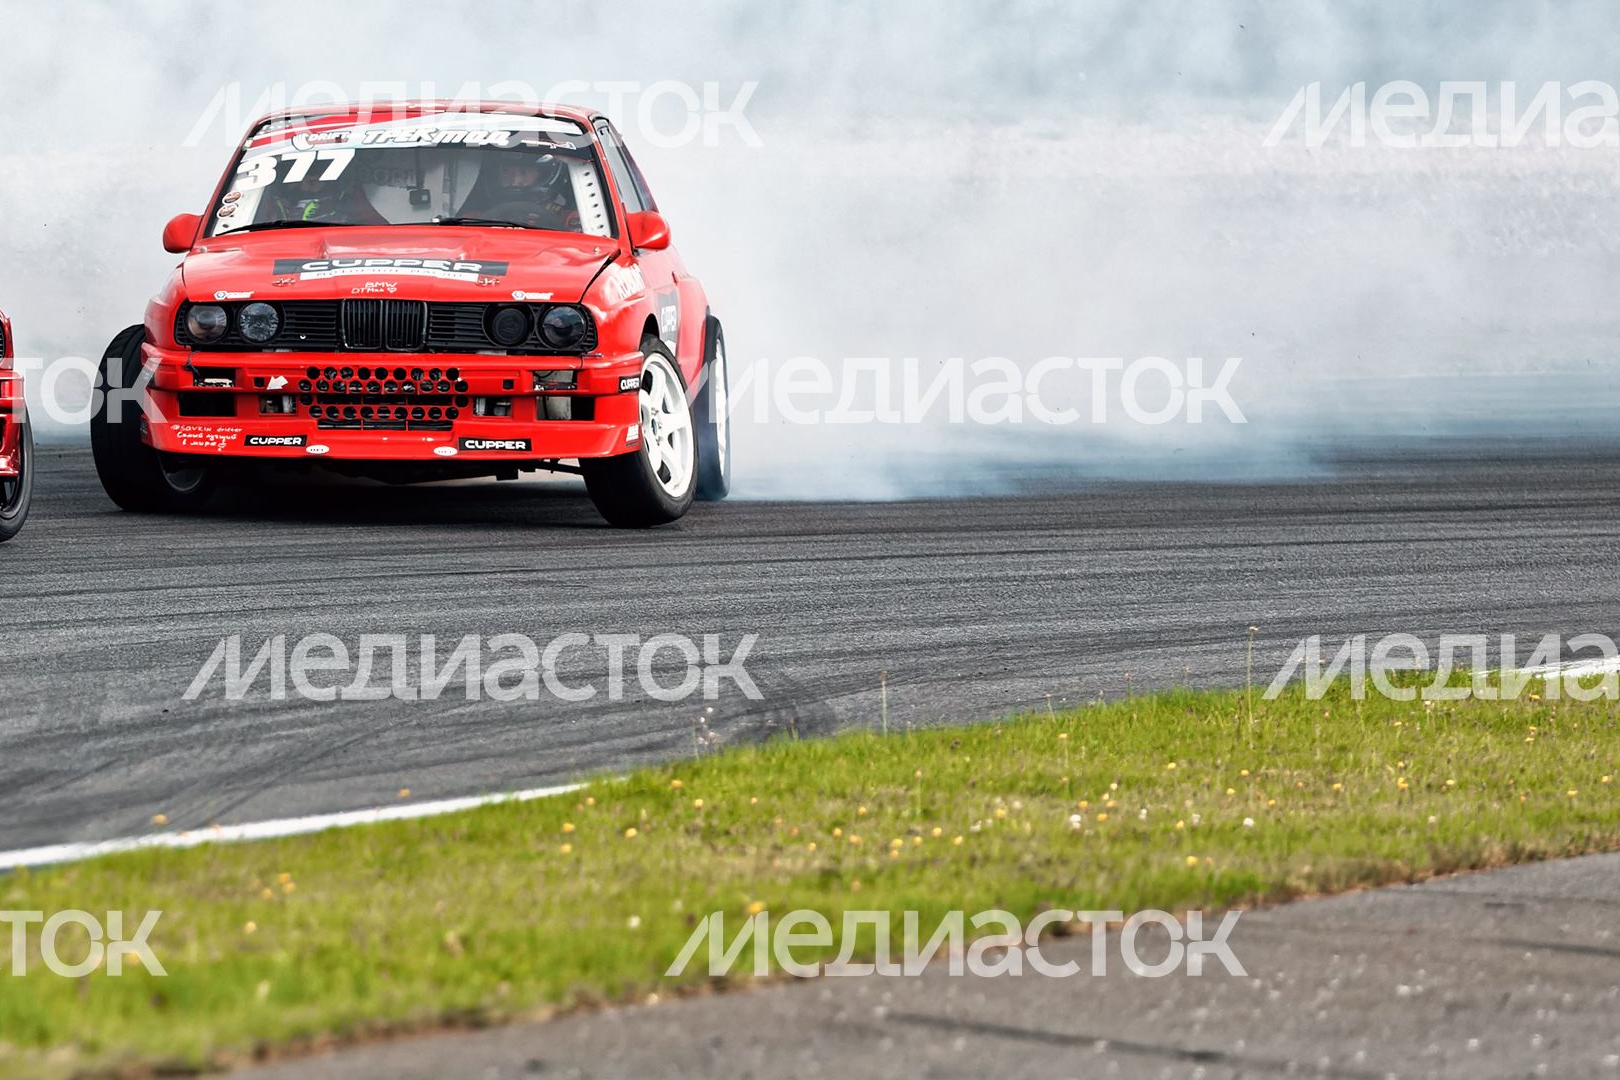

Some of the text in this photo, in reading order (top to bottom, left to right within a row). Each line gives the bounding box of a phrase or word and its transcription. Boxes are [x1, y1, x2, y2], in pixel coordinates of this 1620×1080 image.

[308, 131, 351, 142] DRIFT
[236, 148, 356, 191] 377
[301, 259, 482, 272] CUPPER
[621, 377, 640, 390] CUPPER
[249, 437, 302, 445] CUPPER
[464, 439, 526, 450] CUPPER
